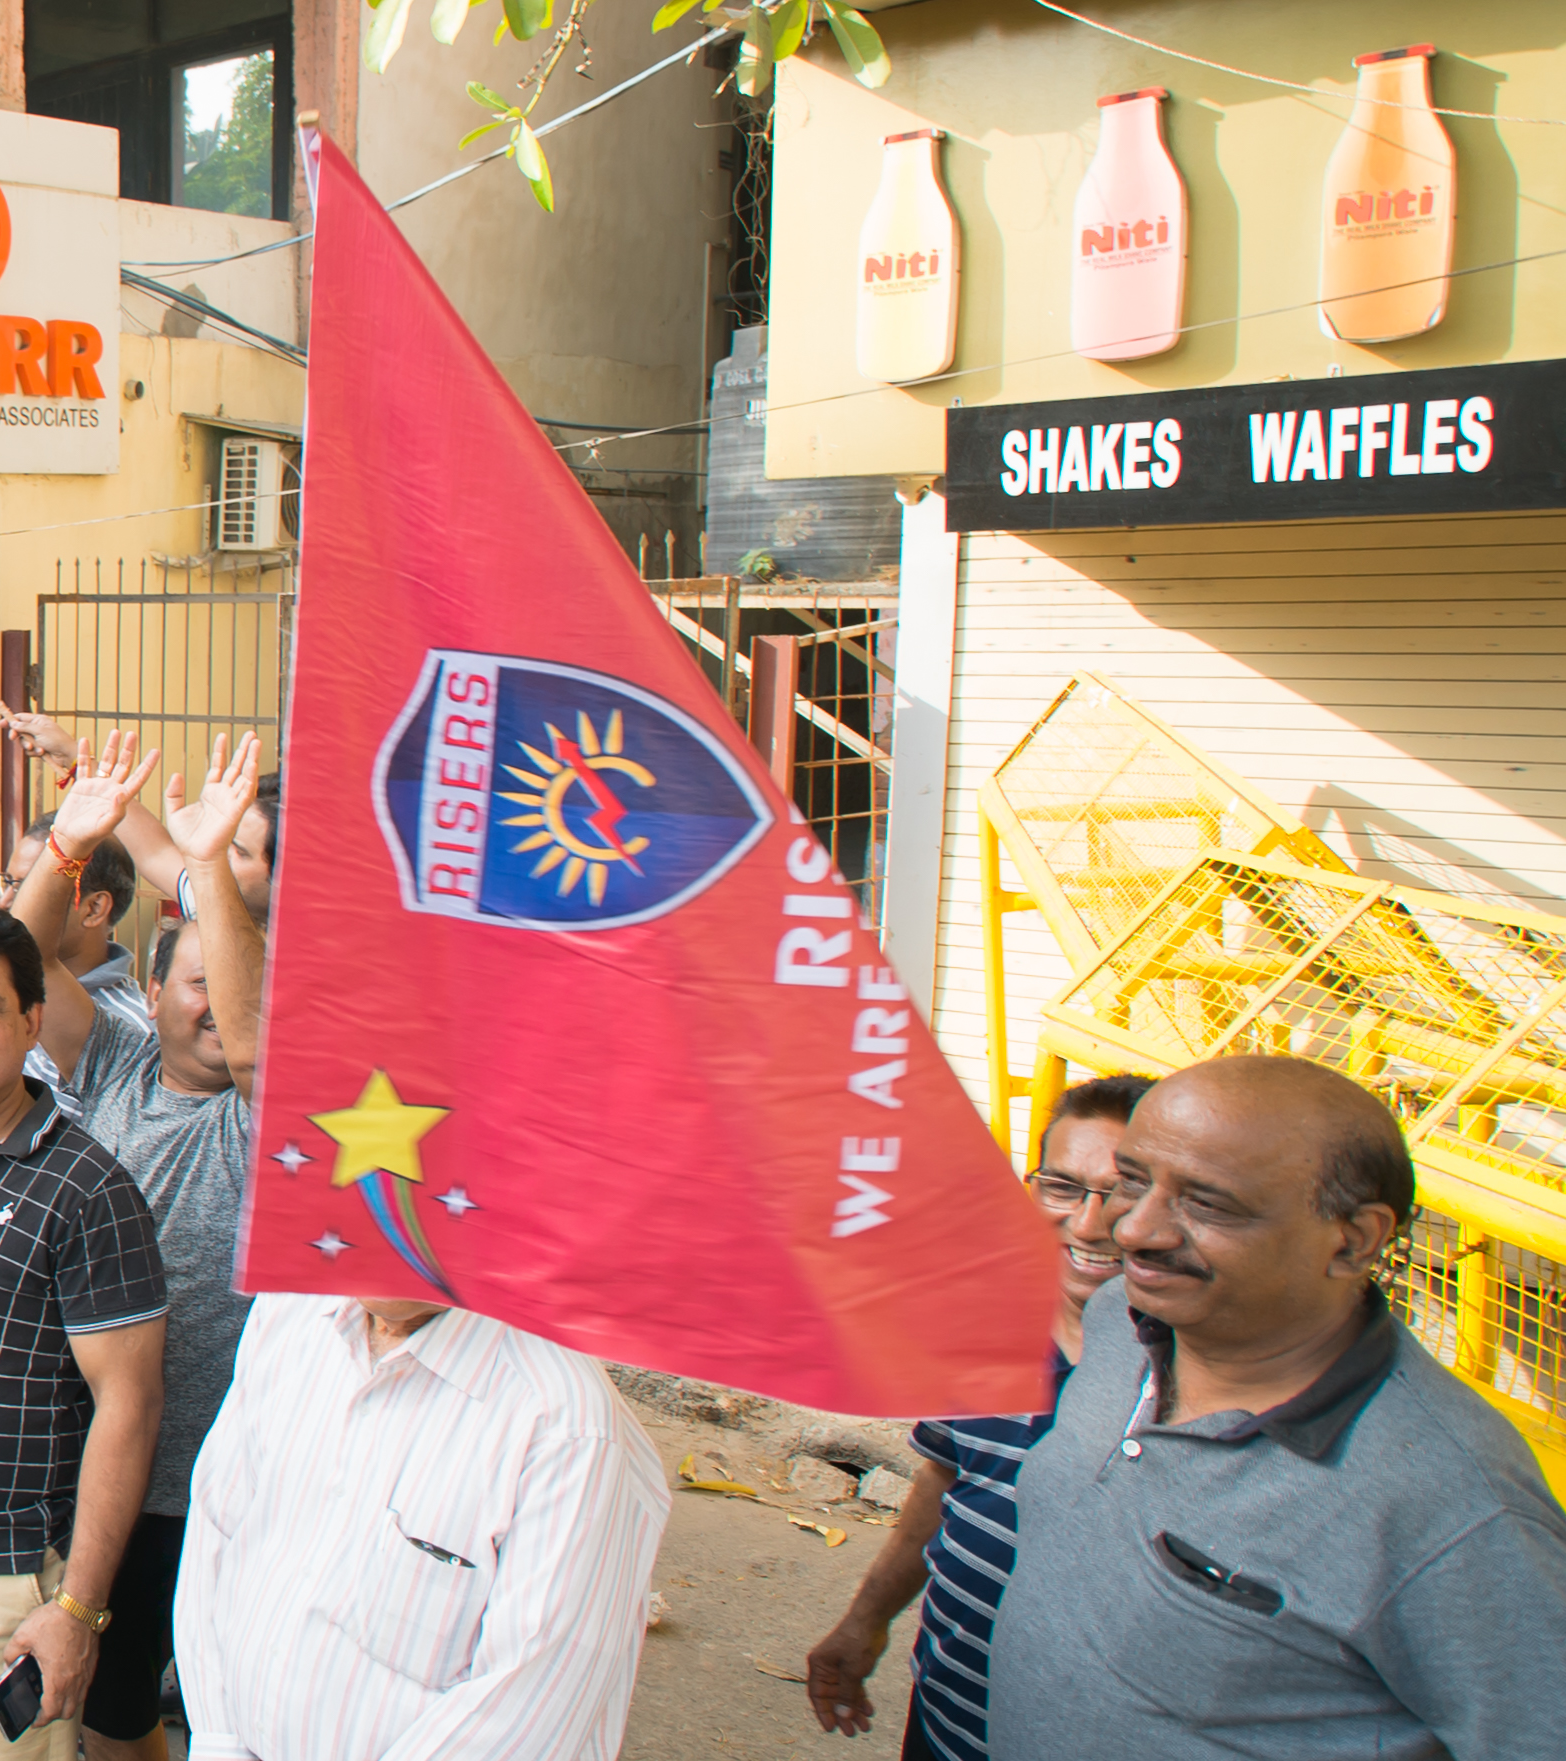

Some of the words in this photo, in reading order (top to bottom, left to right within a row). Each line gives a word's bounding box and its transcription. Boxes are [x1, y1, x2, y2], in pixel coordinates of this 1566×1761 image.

[1081, 215, 1169, 256] Niti
[1334, 185, 1435, 226] Niti
[864, 248, 939, 283] Niti
[999, 418, 1183, 497] SHAKES
[1248, 396, 1494, 485] WAFFLES
[427, 671, 490, 899] RISERS
[846, 963, 912, 1110] ARE
[829, 1135, 902, 1238] WE
